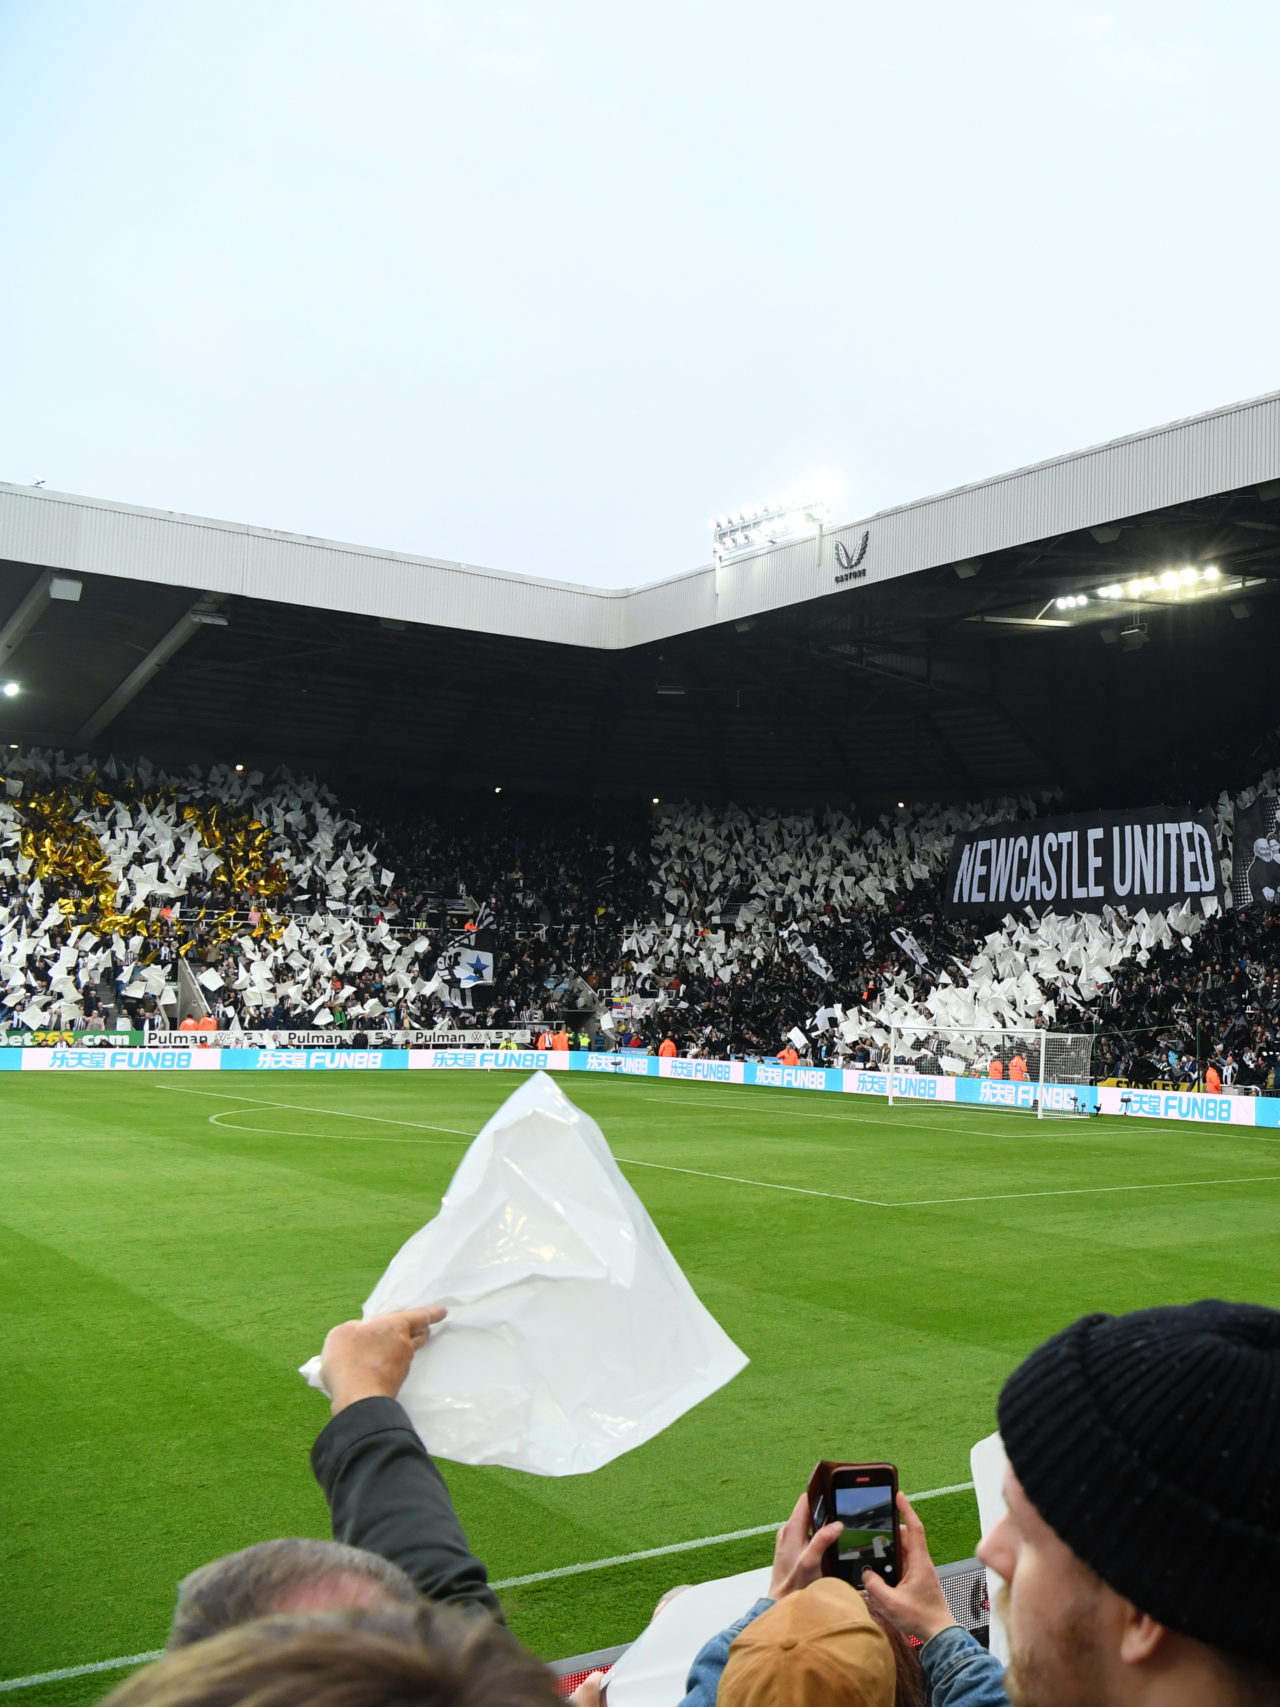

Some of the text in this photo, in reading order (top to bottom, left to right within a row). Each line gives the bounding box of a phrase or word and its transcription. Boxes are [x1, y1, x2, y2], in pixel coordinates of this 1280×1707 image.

[952, 821, 1215, 903] NEWCASTLE UNITED
[0, 1031, 129, 1046] et365com
[148, 1032, 207, 1044] Pulman
[288, 1032, 343, 1044] Pulman
[415, 1031, 466, 1043] Pulman
[50, 1050, 192, 1069] 乐天堂 FUN88
[256, 1050, 383, 1069] 乐天堂 FUN88
[432, 1050, 549, 1069] 乐天堂 FUN88
[694, 1062, 731, 1081] FUN88
[783, 1070, 826, 1090] FUN88
[1118, 1090, 1232, 1122] 乐天堂 FUN88
